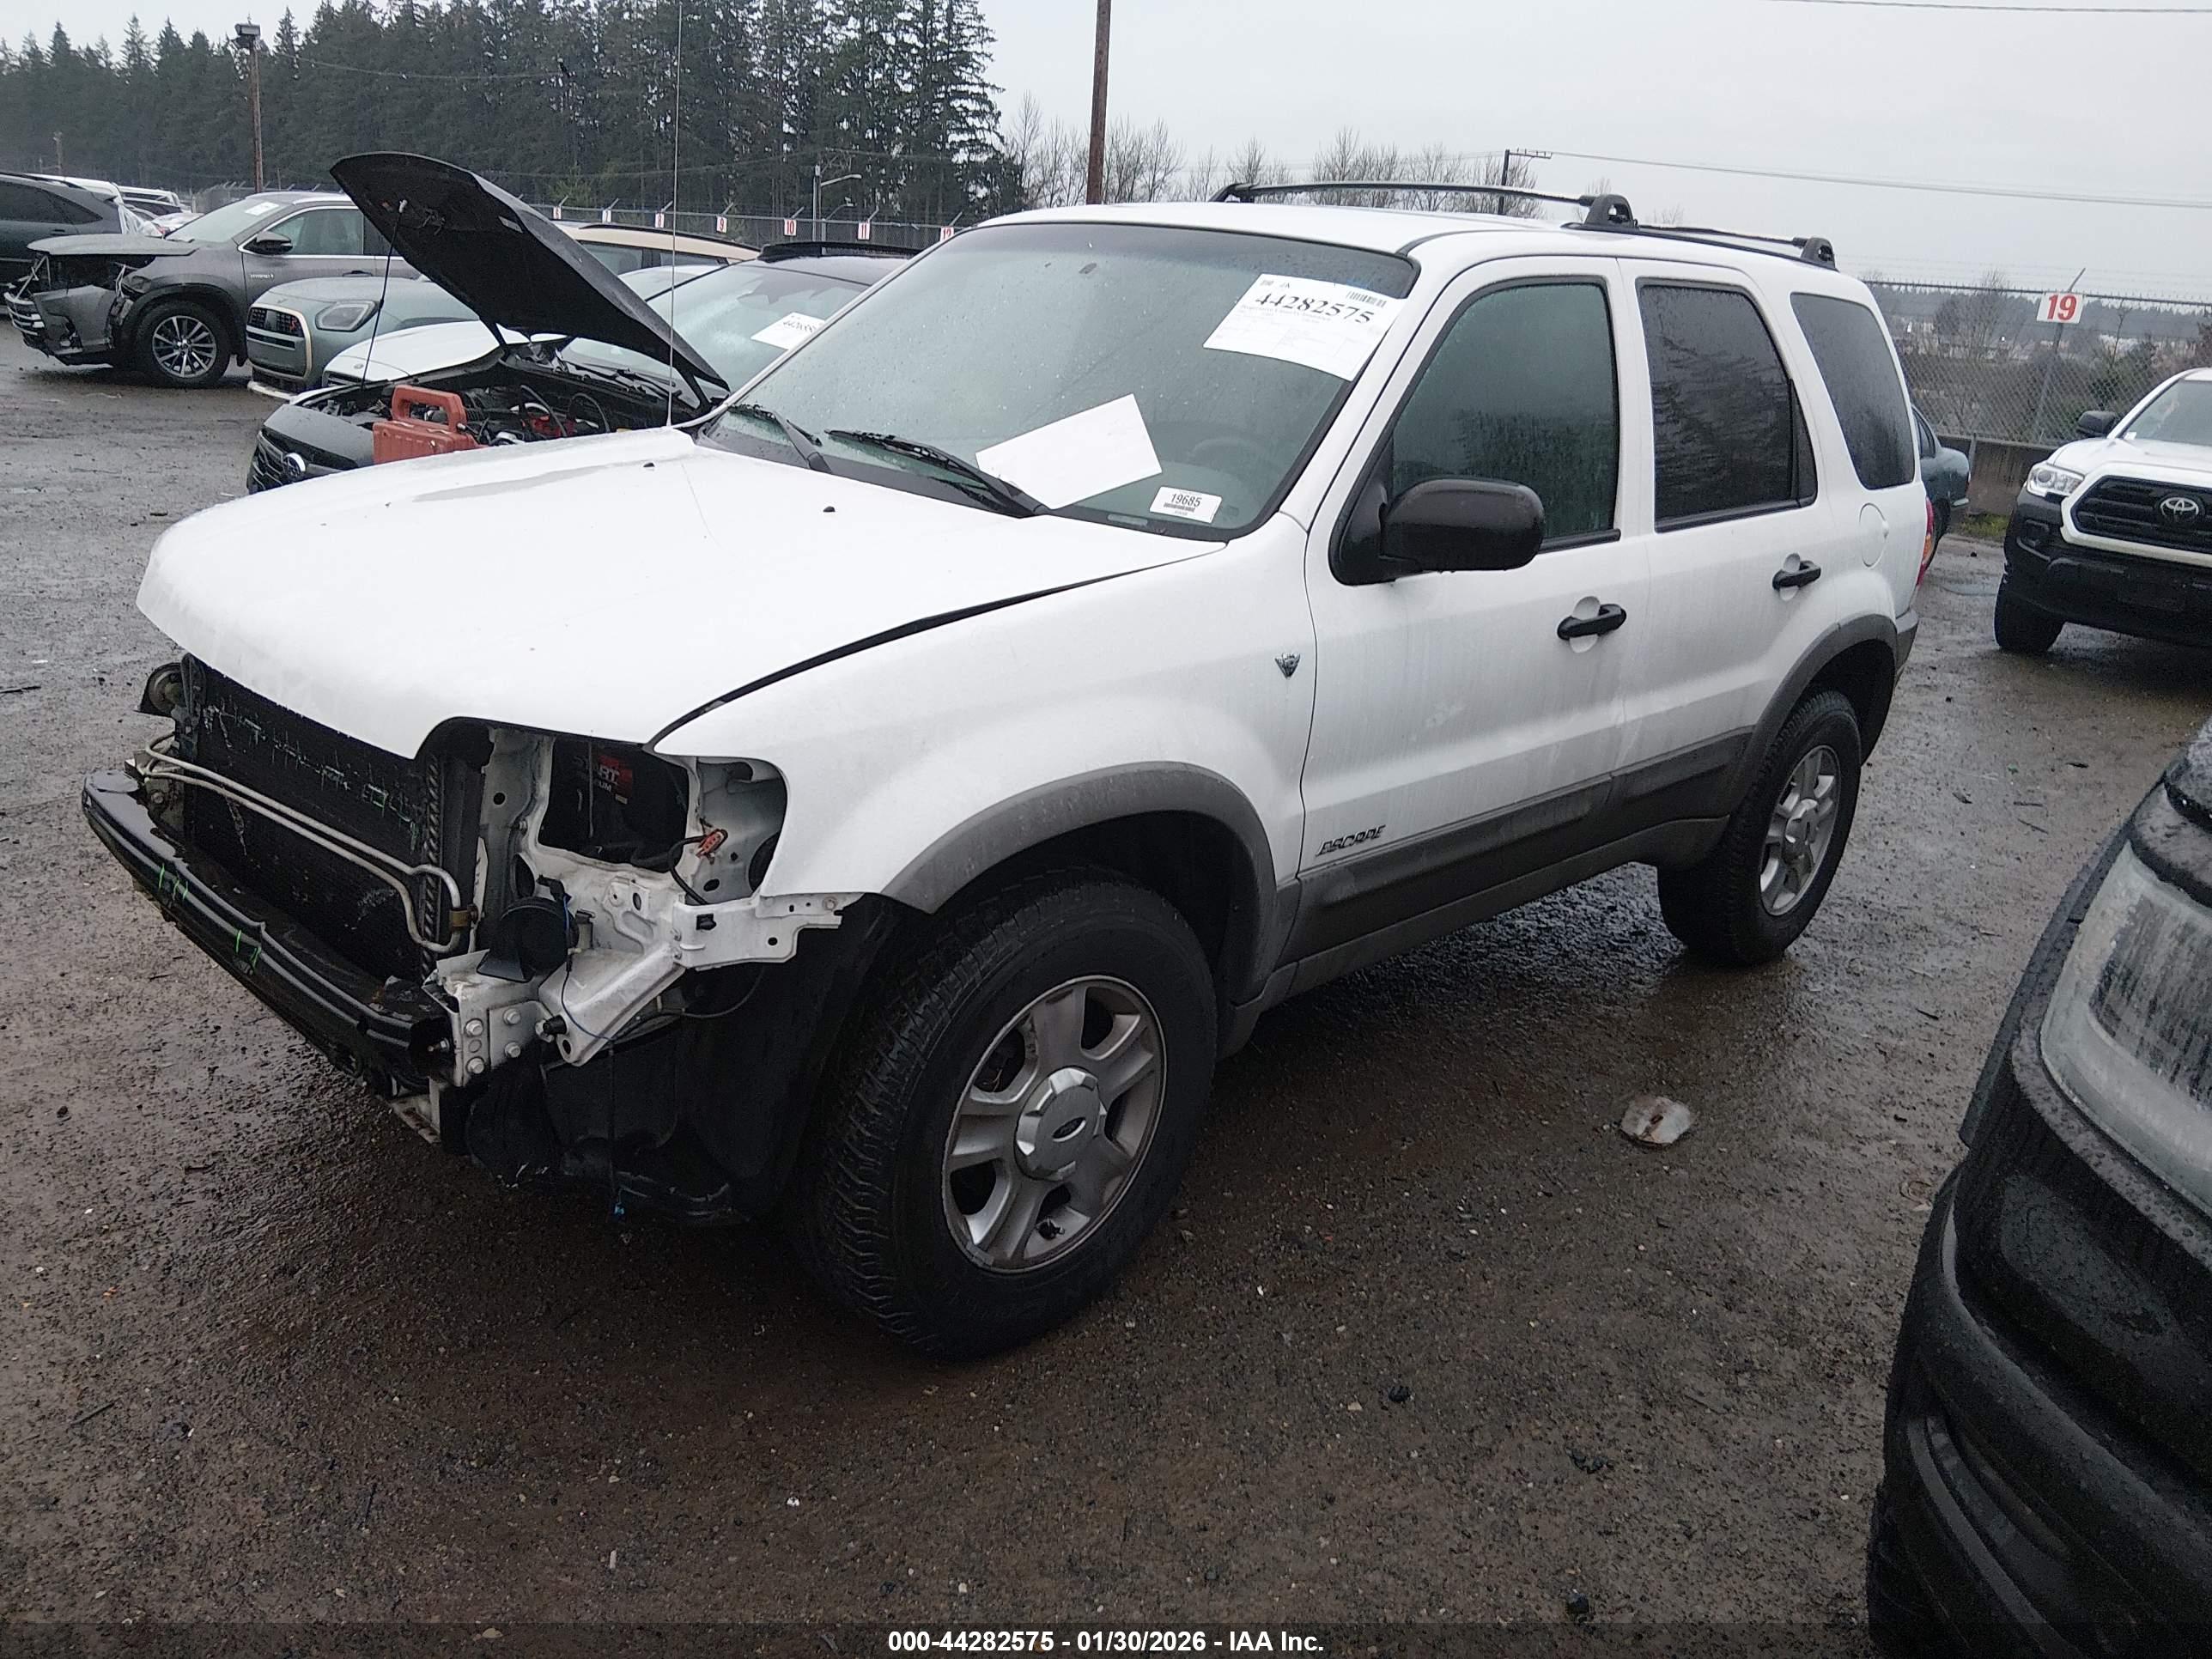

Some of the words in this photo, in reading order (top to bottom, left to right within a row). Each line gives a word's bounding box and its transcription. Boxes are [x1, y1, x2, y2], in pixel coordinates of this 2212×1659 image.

[720, 217, 725, 232] 9
[787, 220, 794, 234] 10
[861, 224, 867, 239] 11
[1255, 293, 1375, 324] 44282575
[2047, 294, 2077, 321] 19
[1170, 493, 1203, 507] 19685
[1315, 824, 1387, 858] ESCAPE
